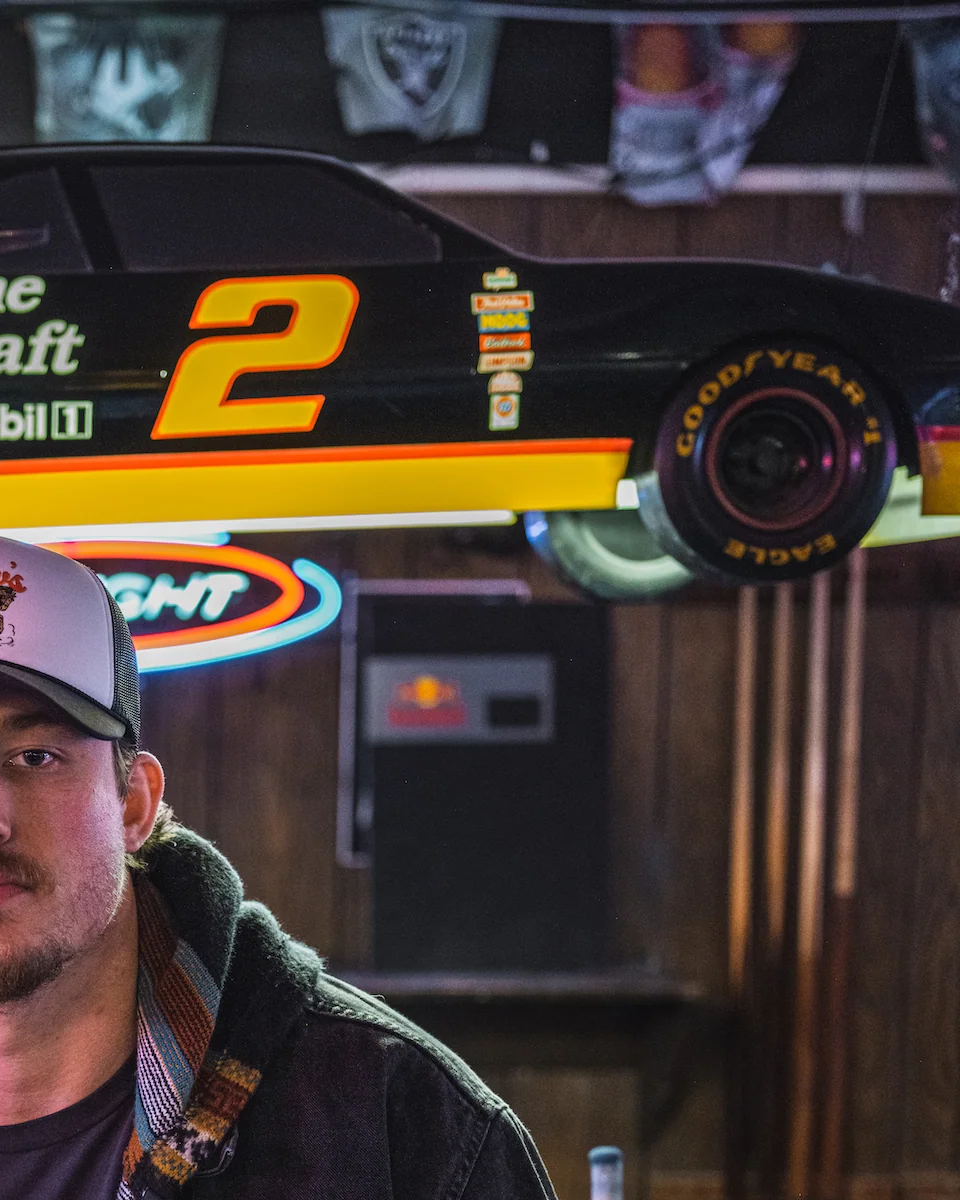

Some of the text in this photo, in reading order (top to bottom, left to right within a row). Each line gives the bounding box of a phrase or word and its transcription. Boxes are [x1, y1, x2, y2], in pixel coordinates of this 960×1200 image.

[150, 273, 360, 441] 2
[52, 401, 93, 441] 1
[676, 349, 867, 457] GOODYEAR
[724, 533, 838, 566] EAGLE
[97, 571, 251, 622] GHT
